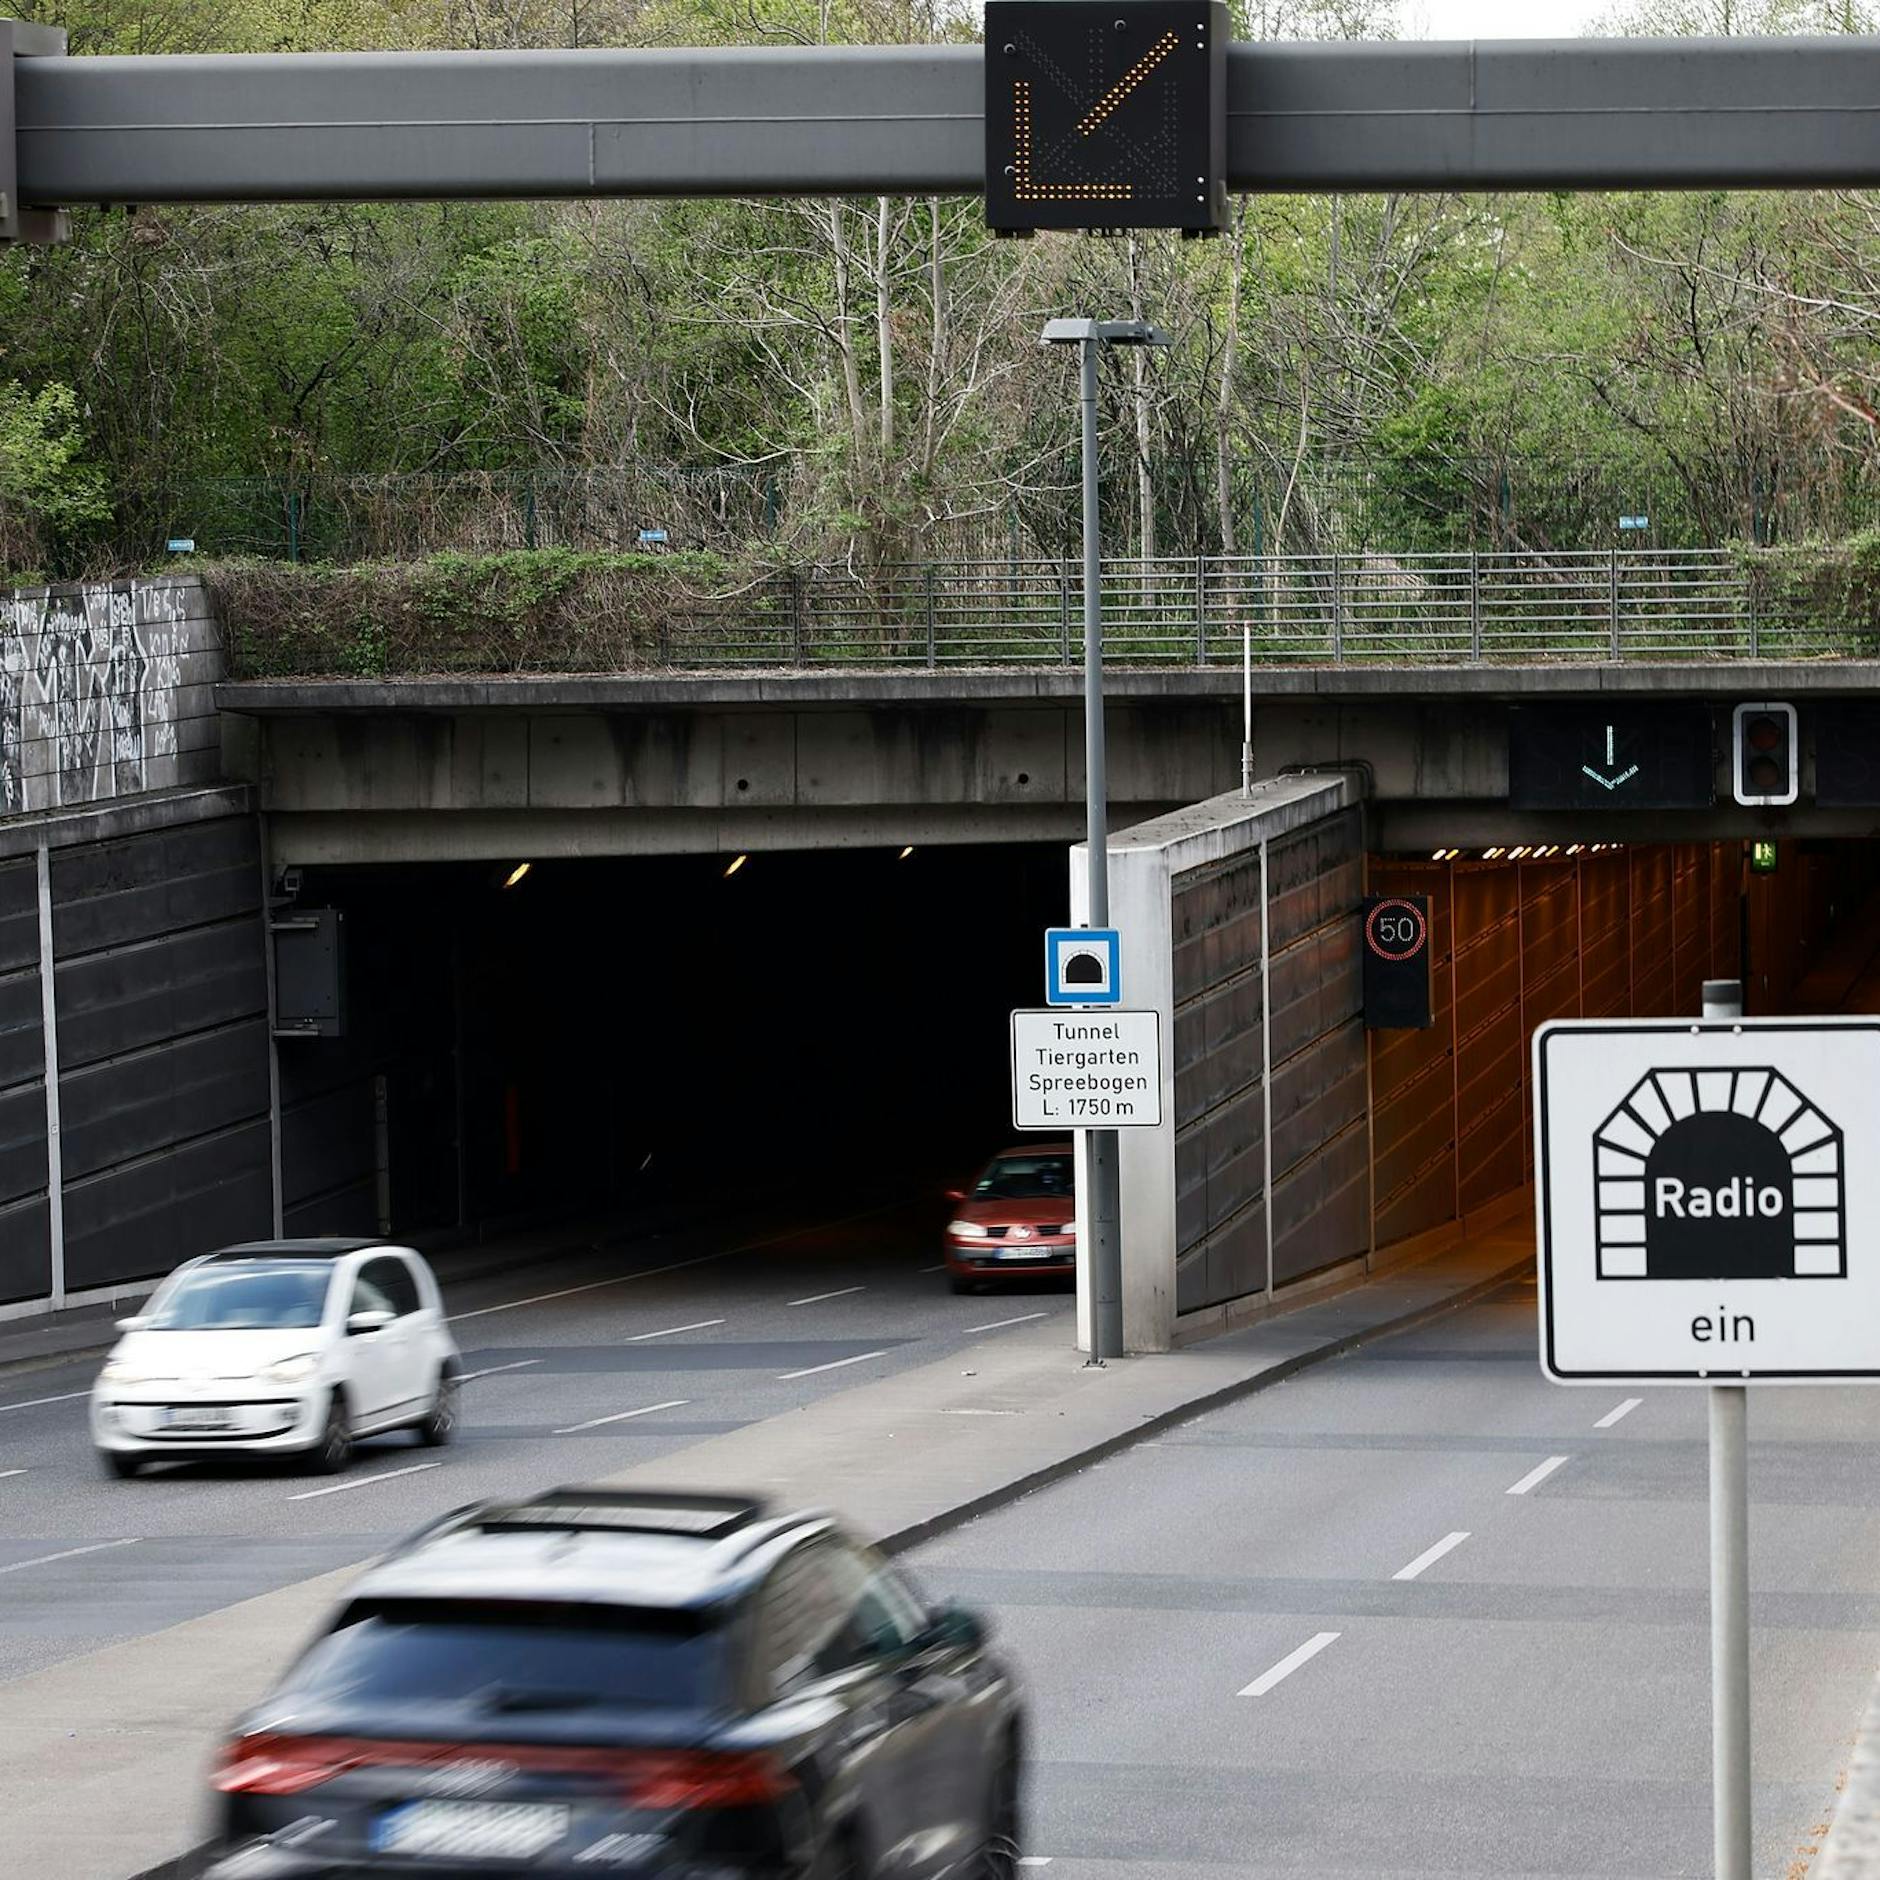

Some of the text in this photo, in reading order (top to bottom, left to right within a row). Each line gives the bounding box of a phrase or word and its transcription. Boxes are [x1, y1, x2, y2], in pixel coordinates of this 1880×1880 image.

[1380, 917, 1414, 942] 50
[1053, 1023, 1120, 1040] Tunnel
[1035, 1048, 1139, 1069] Tiergarten
[1029, 1074, 1147, 1094] Spreebogen
[1043, 1099, 1134, 1116] L: 1750 m
[1654, 1176, 1784, 1218] Radio
[1691, 1305, 1755, 1342] ein
